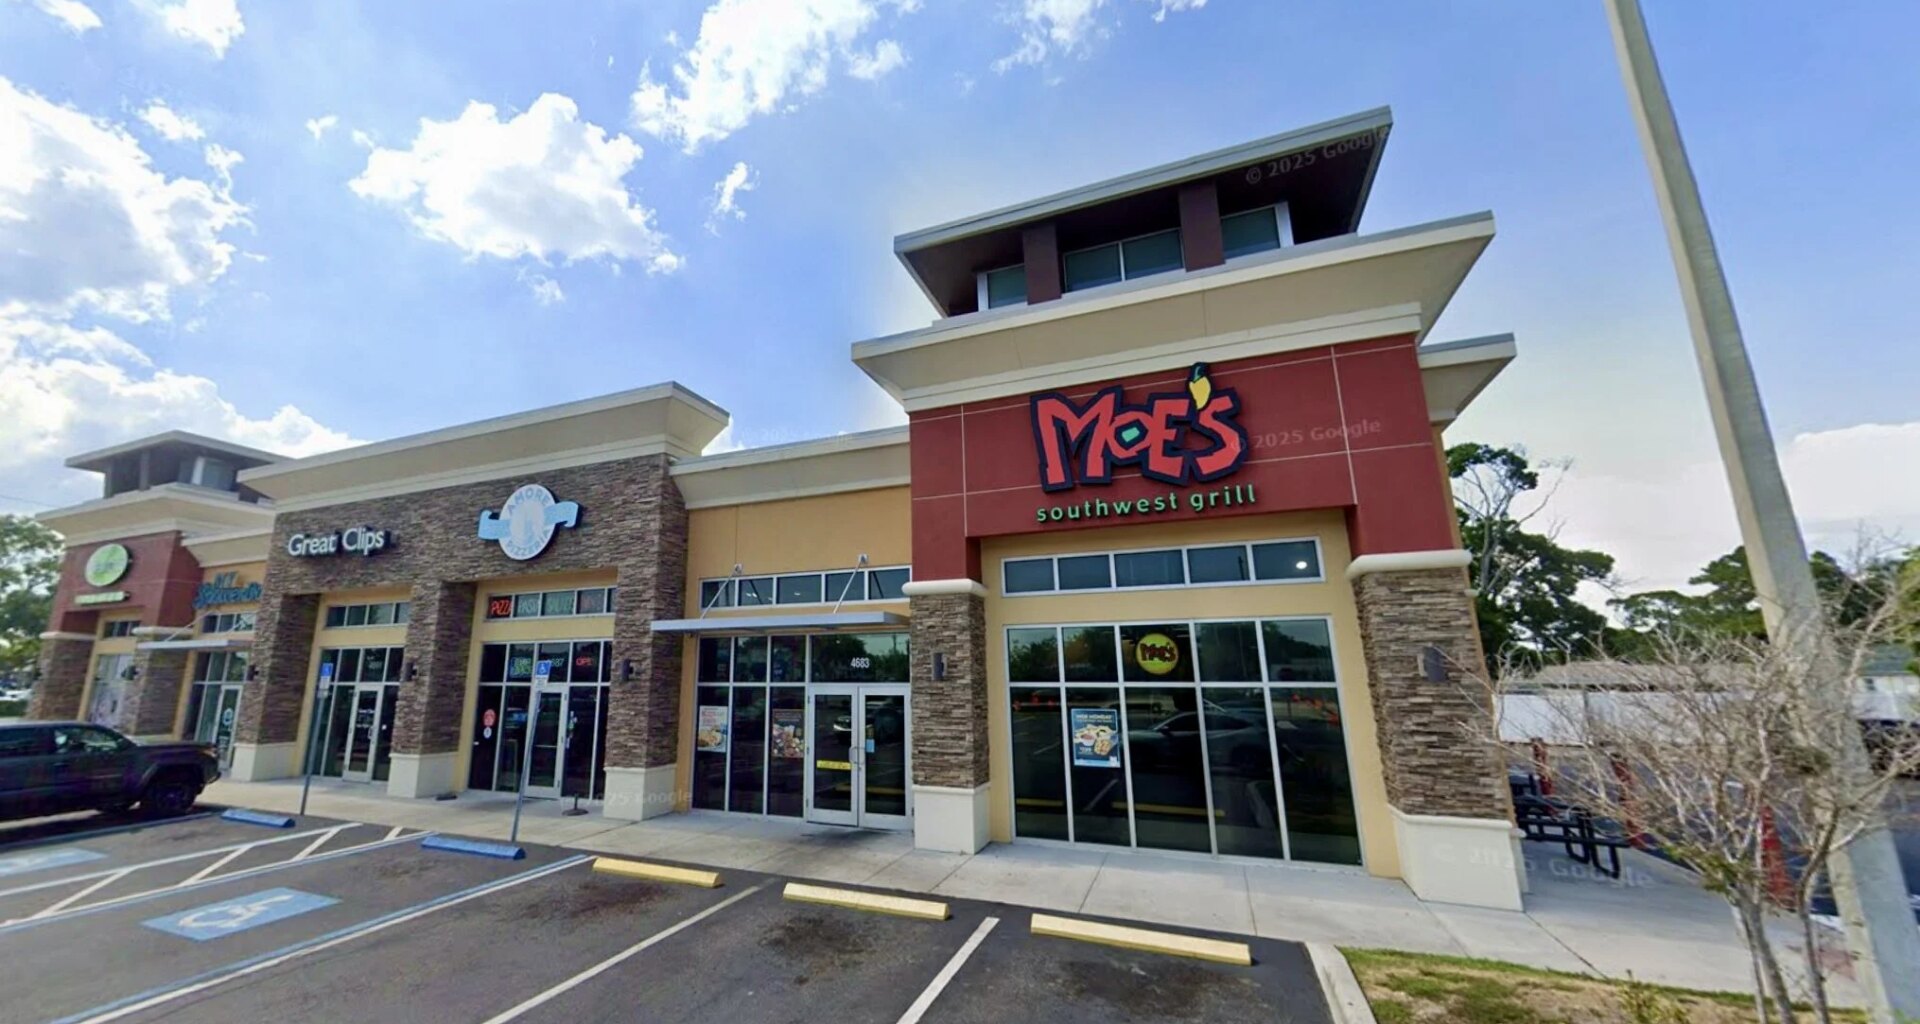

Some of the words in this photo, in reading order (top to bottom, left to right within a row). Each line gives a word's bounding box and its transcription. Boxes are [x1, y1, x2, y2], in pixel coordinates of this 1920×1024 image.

[507, 487, 551, 516] AMORE
[1036, 492, 1179, 523] southwest
[1190, 484, 1257, 512] grill
[287, 533, 338, 556] Great
[341, 526, 386, 556] Clips
[850, 656, 871, 669] 4683
